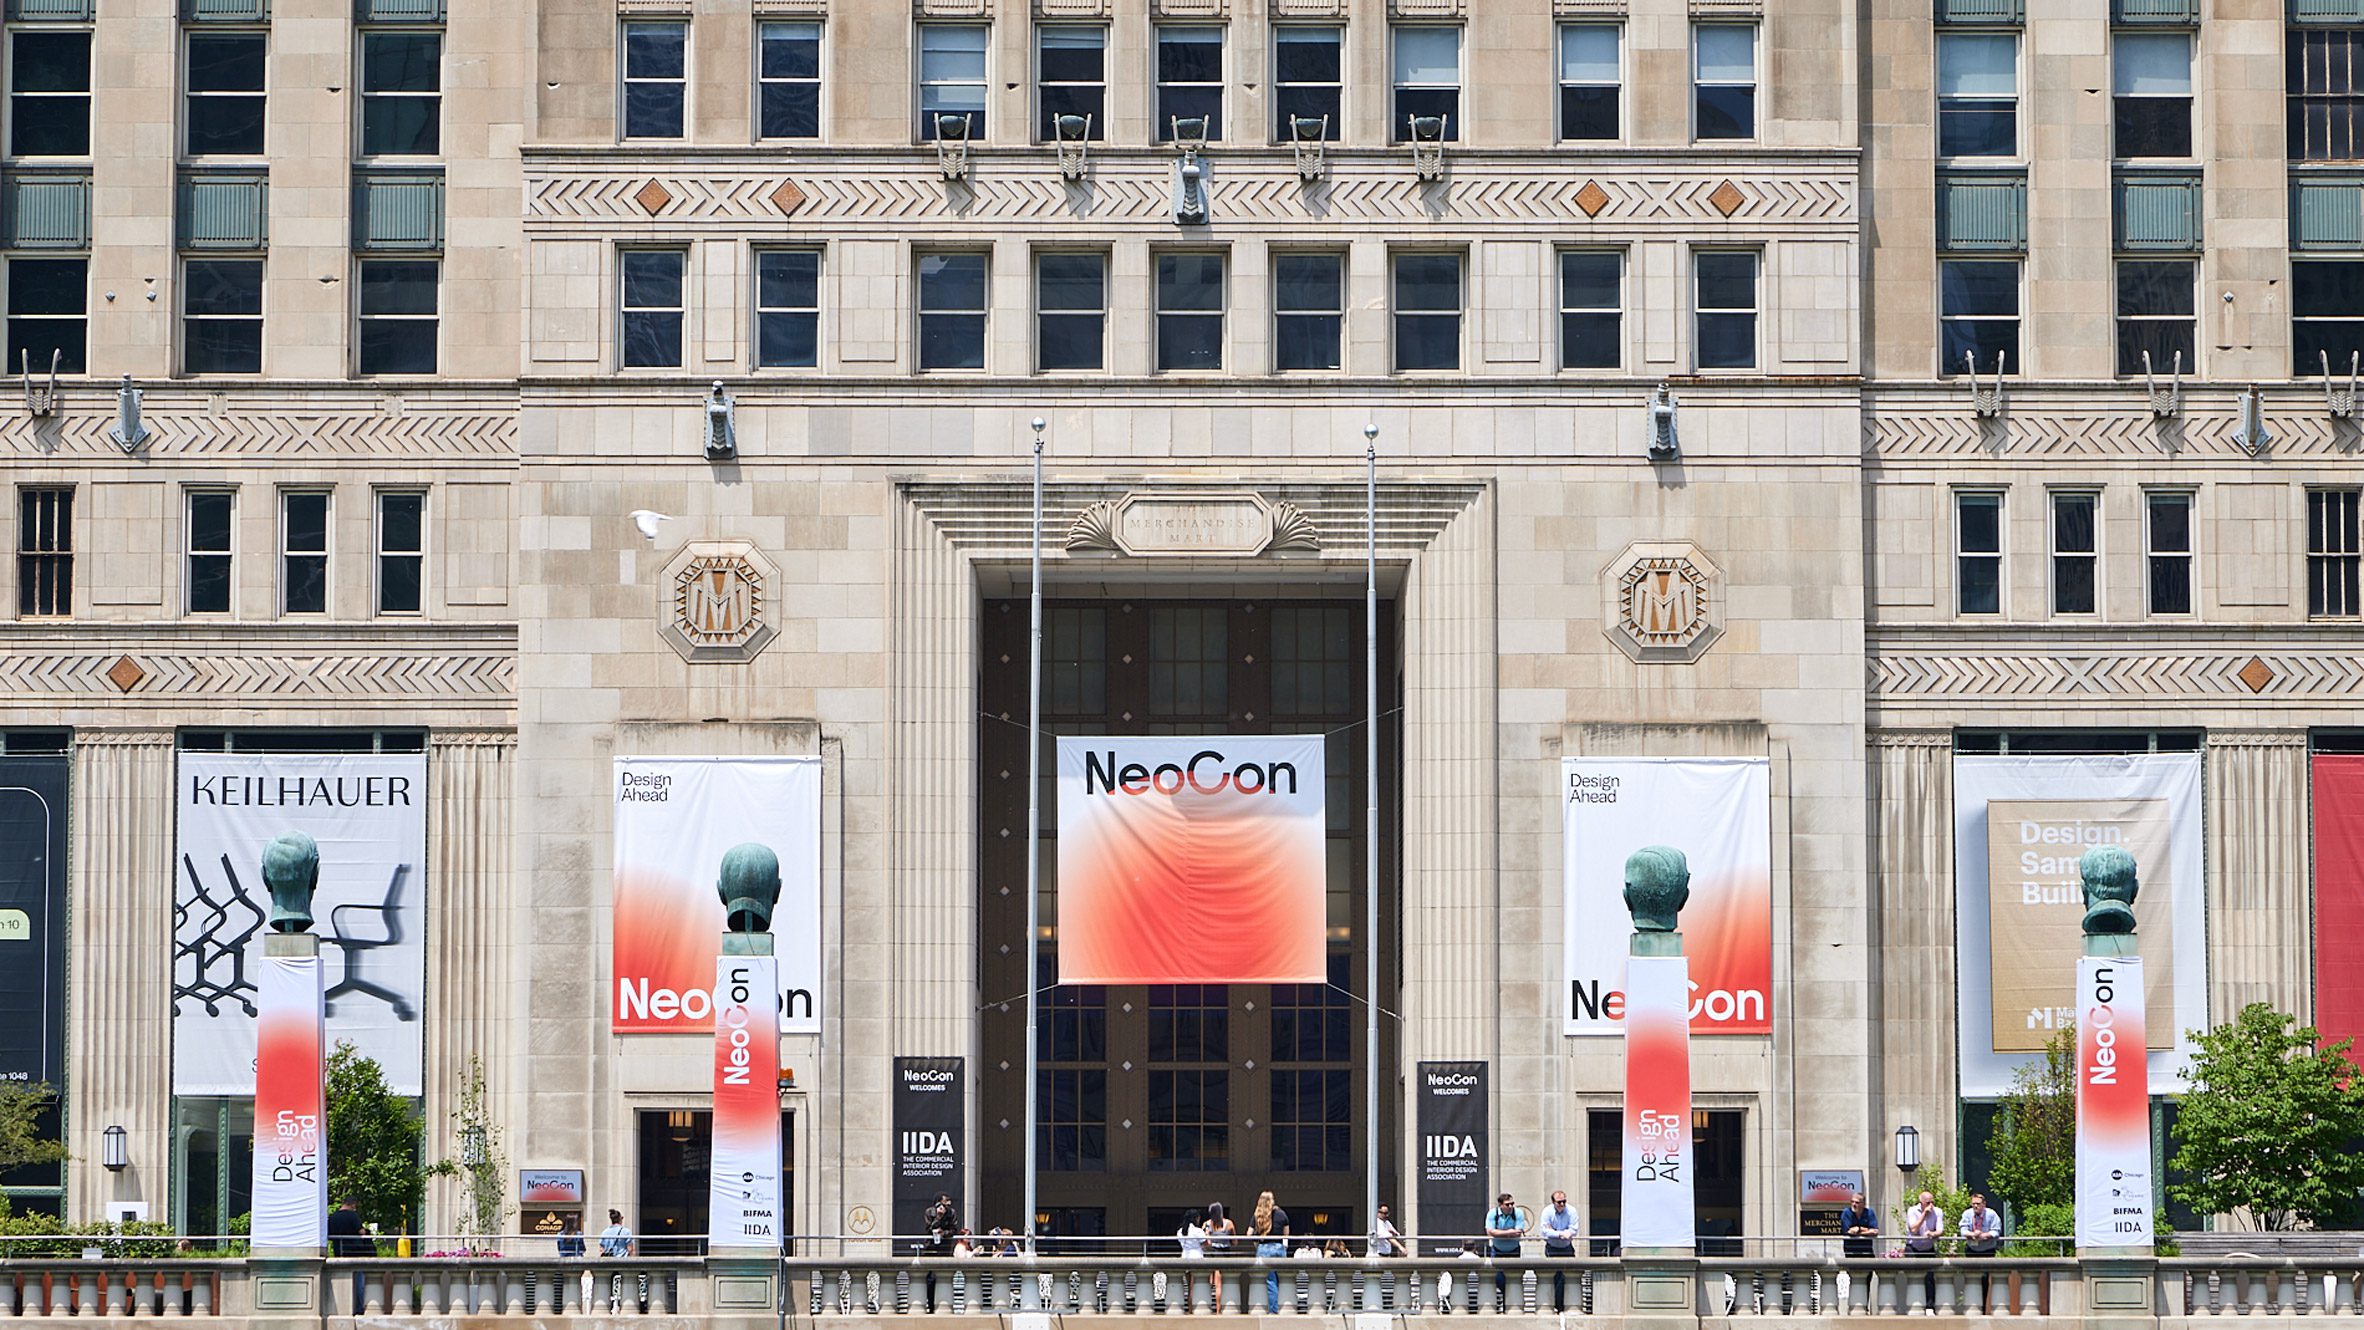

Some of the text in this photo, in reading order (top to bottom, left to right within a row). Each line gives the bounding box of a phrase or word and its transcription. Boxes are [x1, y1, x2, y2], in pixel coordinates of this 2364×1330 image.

[1130, 519, 1256, 528] MERCHANDISE
[1169, 534, 1216, 543] MART
[622, 772, 672, 790] Design
[1085, 750, 1297, 795] NeoCon
[1570, 773, 1620, 791] Design
[193, 776, 411, 807] KEILHAUER
[621, 788, 668, 802] Ahead
[1569, 789, 1616, 803] Ahead
[2020, 820, 2130, 848] Design.
[2020, 851, 2081, 875] Sam
[2022, 881, 2084, 905] Buil
[7, 919, 20, 930] 10
[723, 968, 750, 1084] NeoCon
[2089, 969, 2117, 1085] NeoCon
[904, 1069, 954, 1081] NeoCon
[1427, 1073, 1478, 1086] NeoCon
[273, 1110, 299, 1182] Design
[296, 1115, 316, 1183] Ahead
[902, 1132, 954, 1154] IIDA
[1426, 1136, 1478, 1158] IIDA
[1636, 1109, 1662, 1181] Design
[1658, 1115, 1680, 1182] Ahead
[527, 1180, 575, 1190] NeoCon
[1808, 1180, 1855, 1190] NeoCon
[2113, 1207, 2143, 1215] BIFMA
[744, 1224, 771, 1235] IIDA
[2115, 1222, 2142, 1233] IIDA
